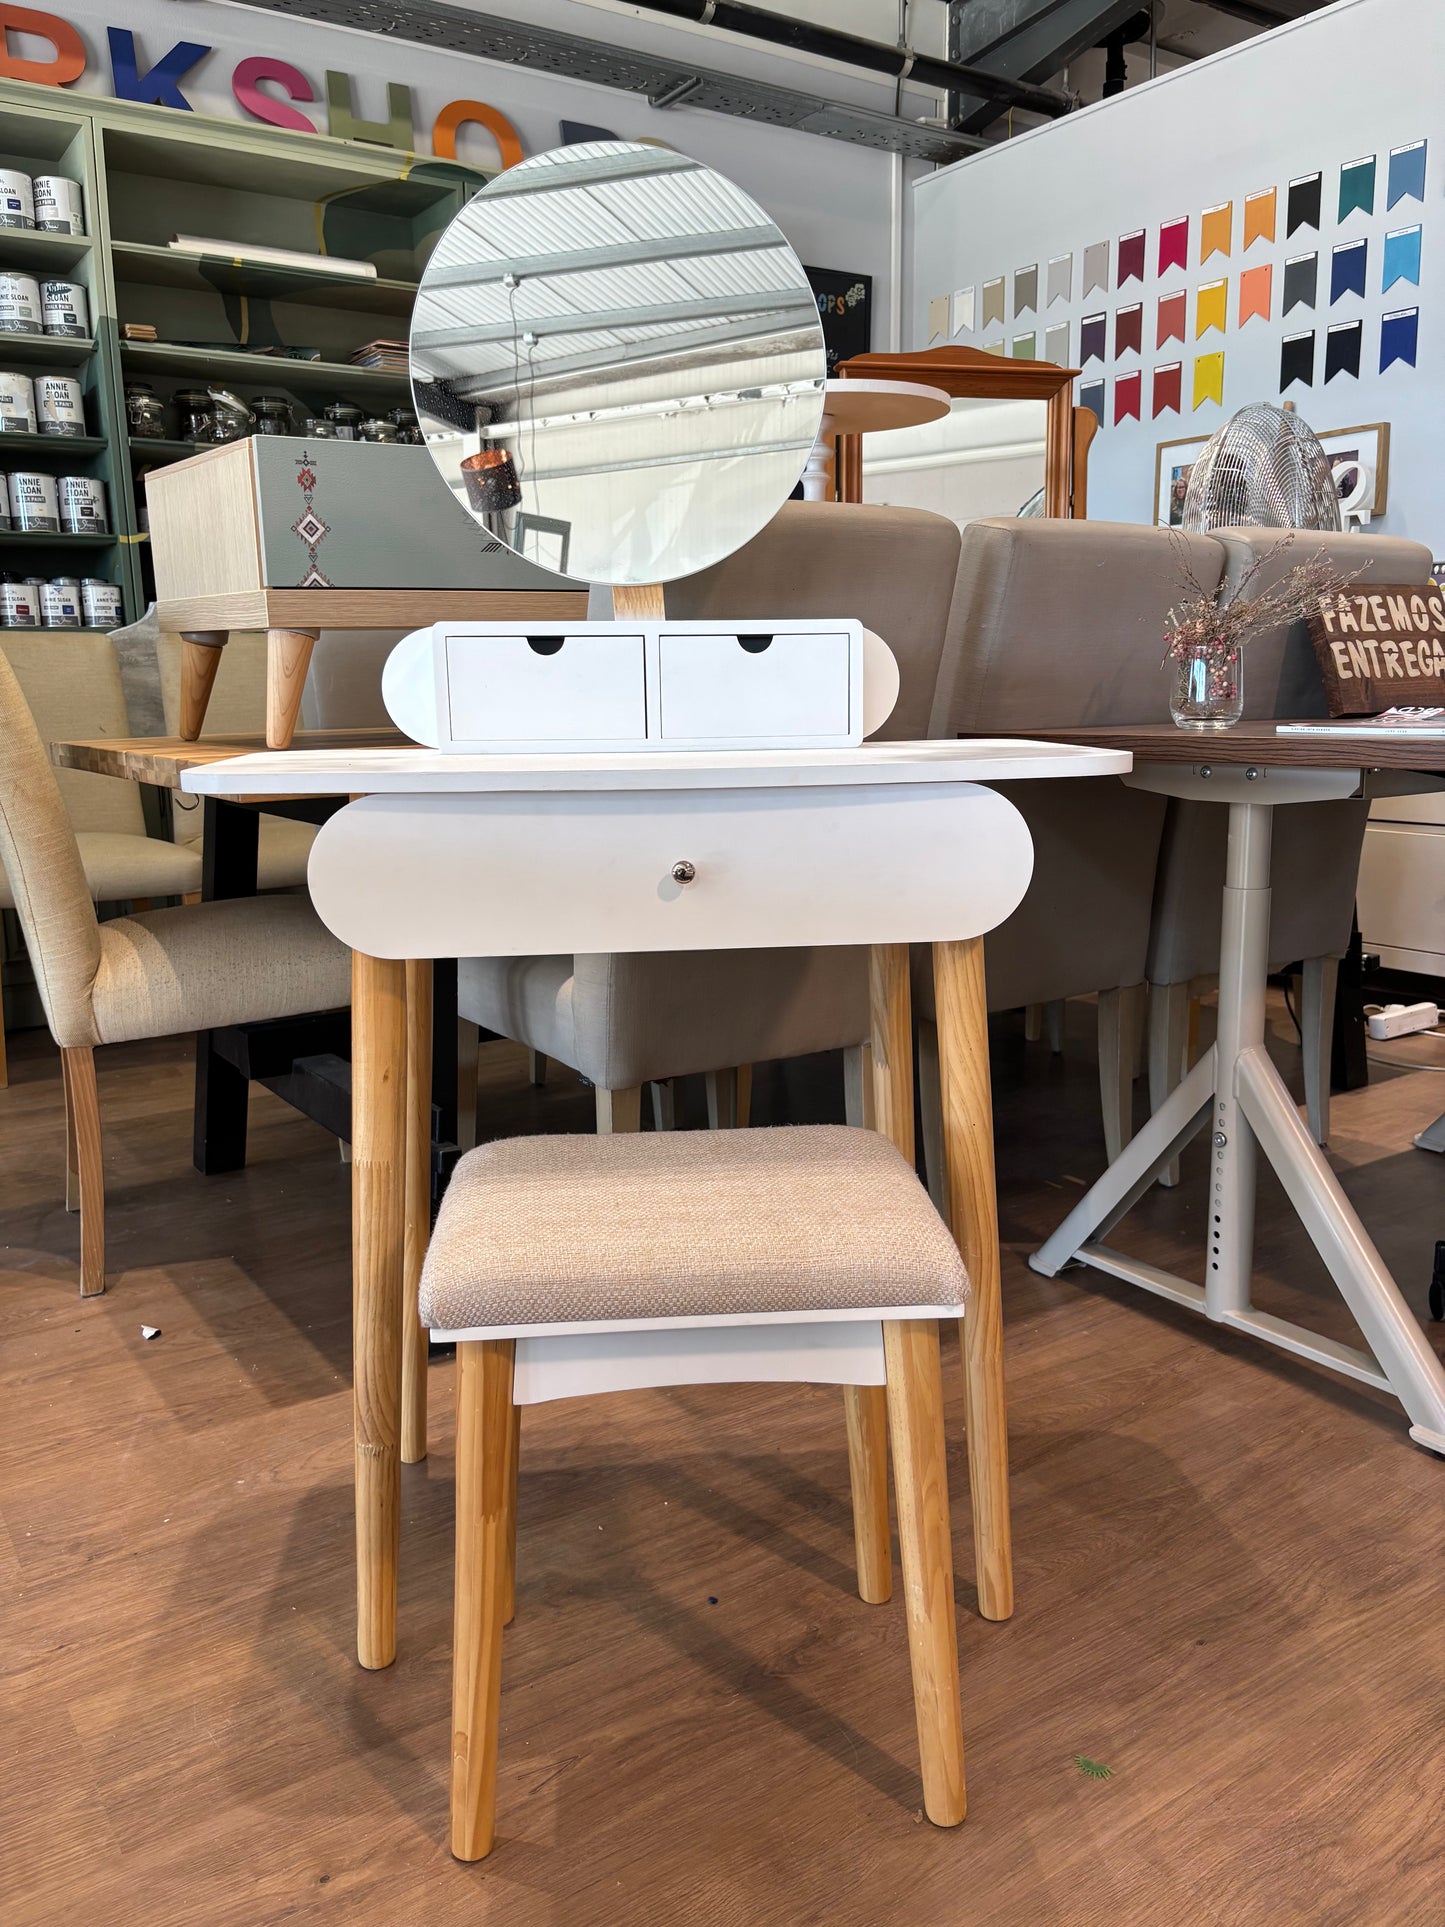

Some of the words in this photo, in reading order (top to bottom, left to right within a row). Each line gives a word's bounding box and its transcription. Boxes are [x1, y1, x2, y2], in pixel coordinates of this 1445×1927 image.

[0, 3, 674, 174] RKSHO
[10, 293, 29, 302] SLOAN
[46, 293, 70, 303] SLOAN
[45, 382, 69, 392] ANNIE
[18, 478, 41, 487] ANNIE
[66, 481, 89, 489] ANNIE
[66, 489, 89, 497] SLOAN
[1318, 593, 1445, 633] FAZEMOS
